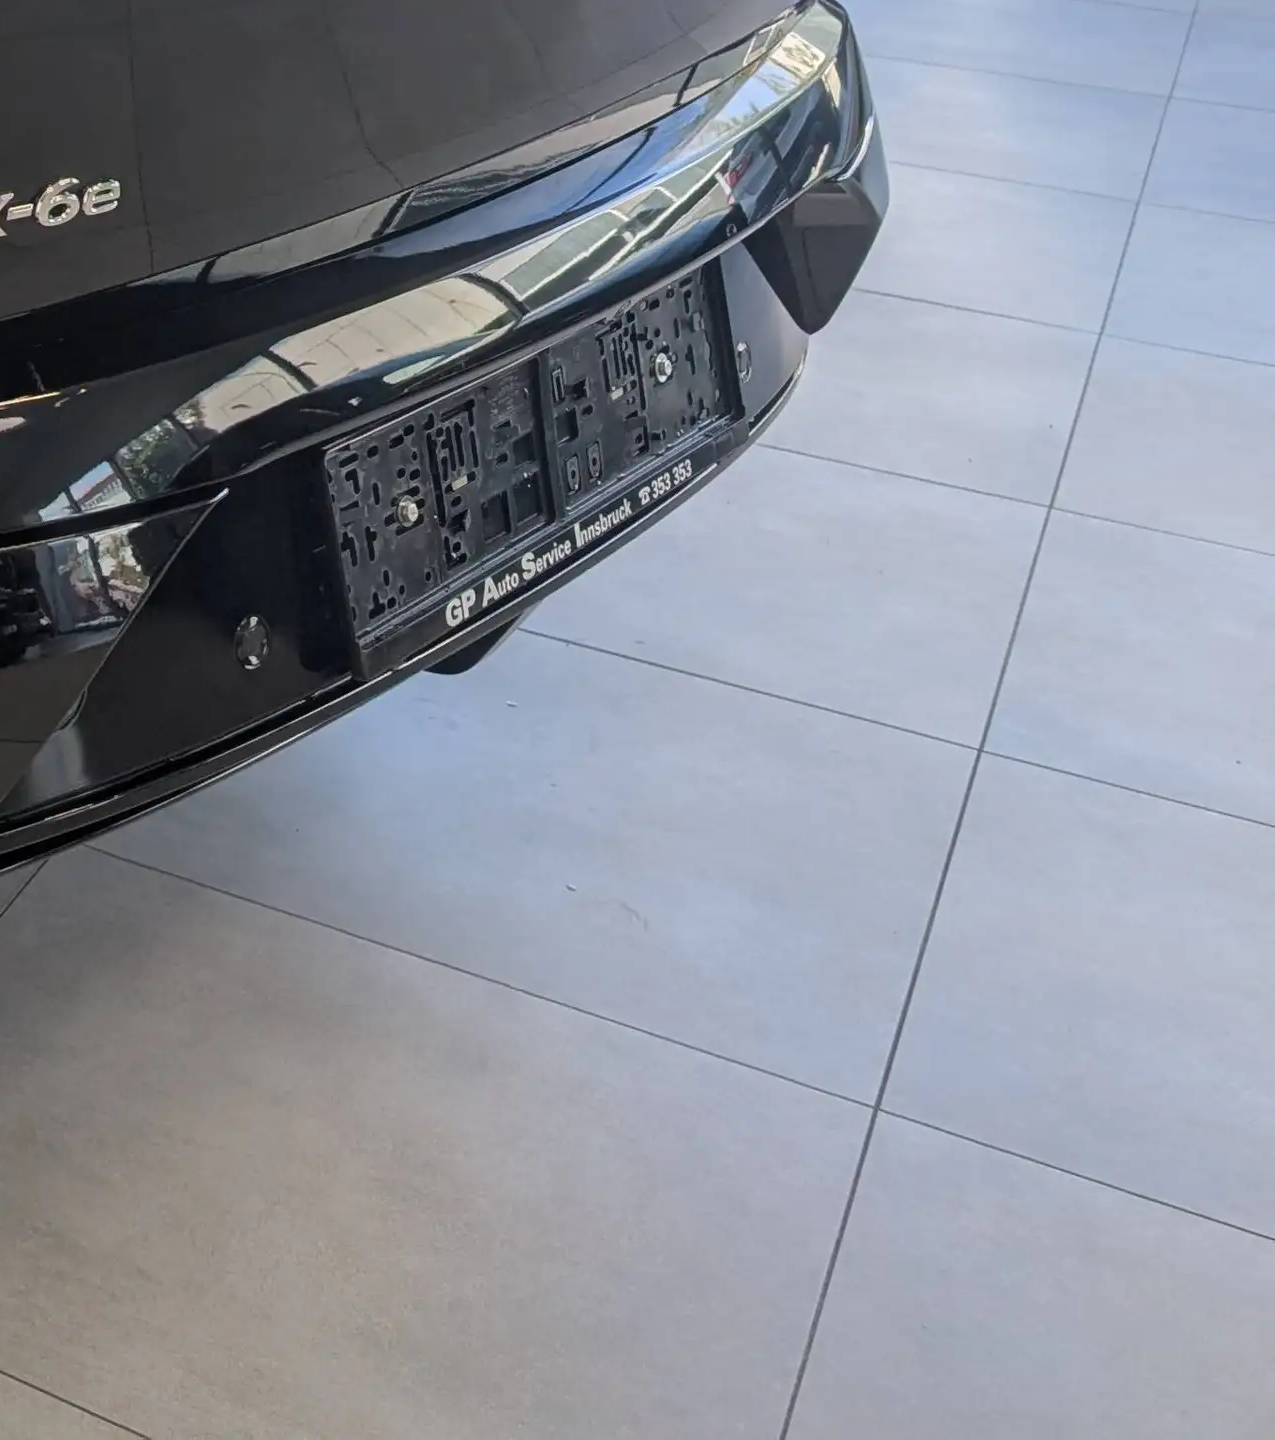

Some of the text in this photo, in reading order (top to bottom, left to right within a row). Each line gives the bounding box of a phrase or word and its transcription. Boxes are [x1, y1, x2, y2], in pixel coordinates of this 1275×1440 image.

[445, 459, 693, 627] GP Auto Service Innsbruck 353 353
